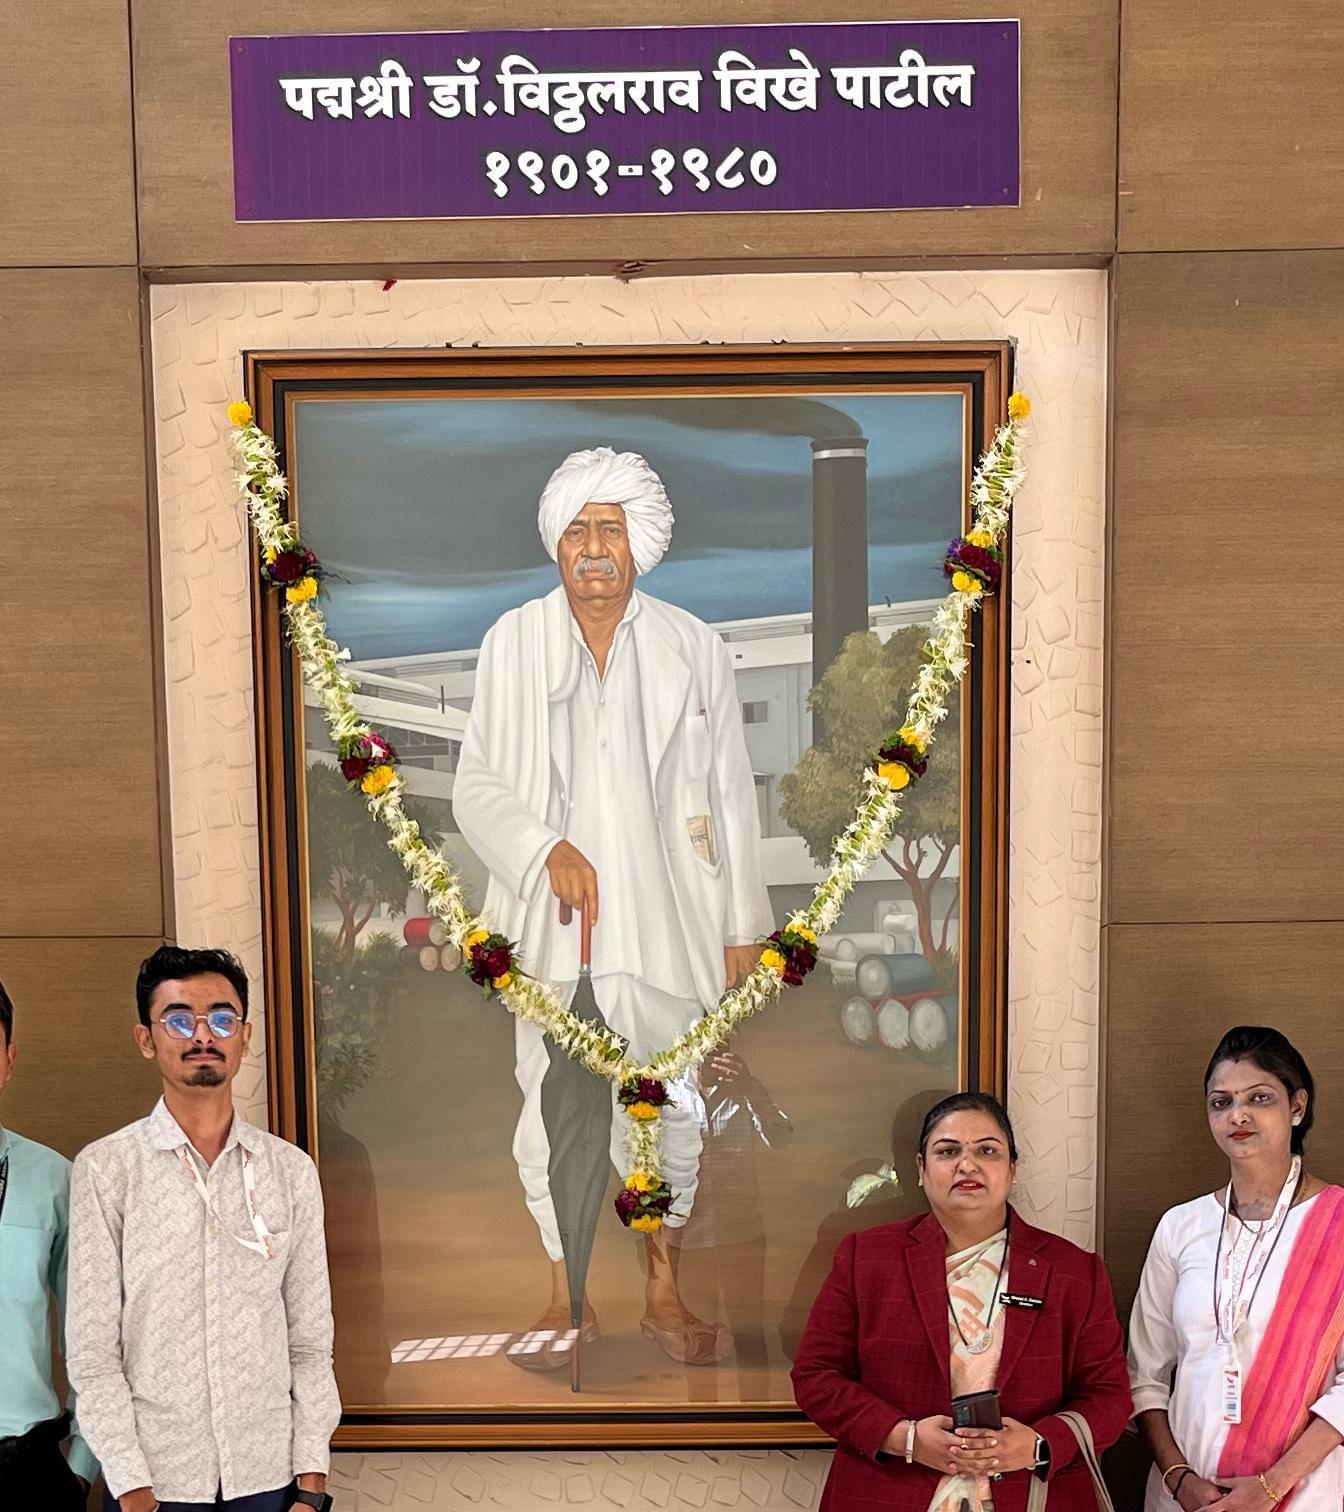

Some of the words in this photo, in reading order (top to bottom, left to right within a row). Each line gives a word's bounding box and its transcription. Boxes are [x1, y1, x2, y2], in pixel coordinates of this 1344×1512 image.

[278, 59, 414, 120] पद्मश्री
[422, 54, 703, 134] डॉ.विठ्ठलराव
[712, 48, 821, 112] विखे
[830, 48, 976, 109] पाटील
[485, 146, 777, 198] १९०१-१९८०
